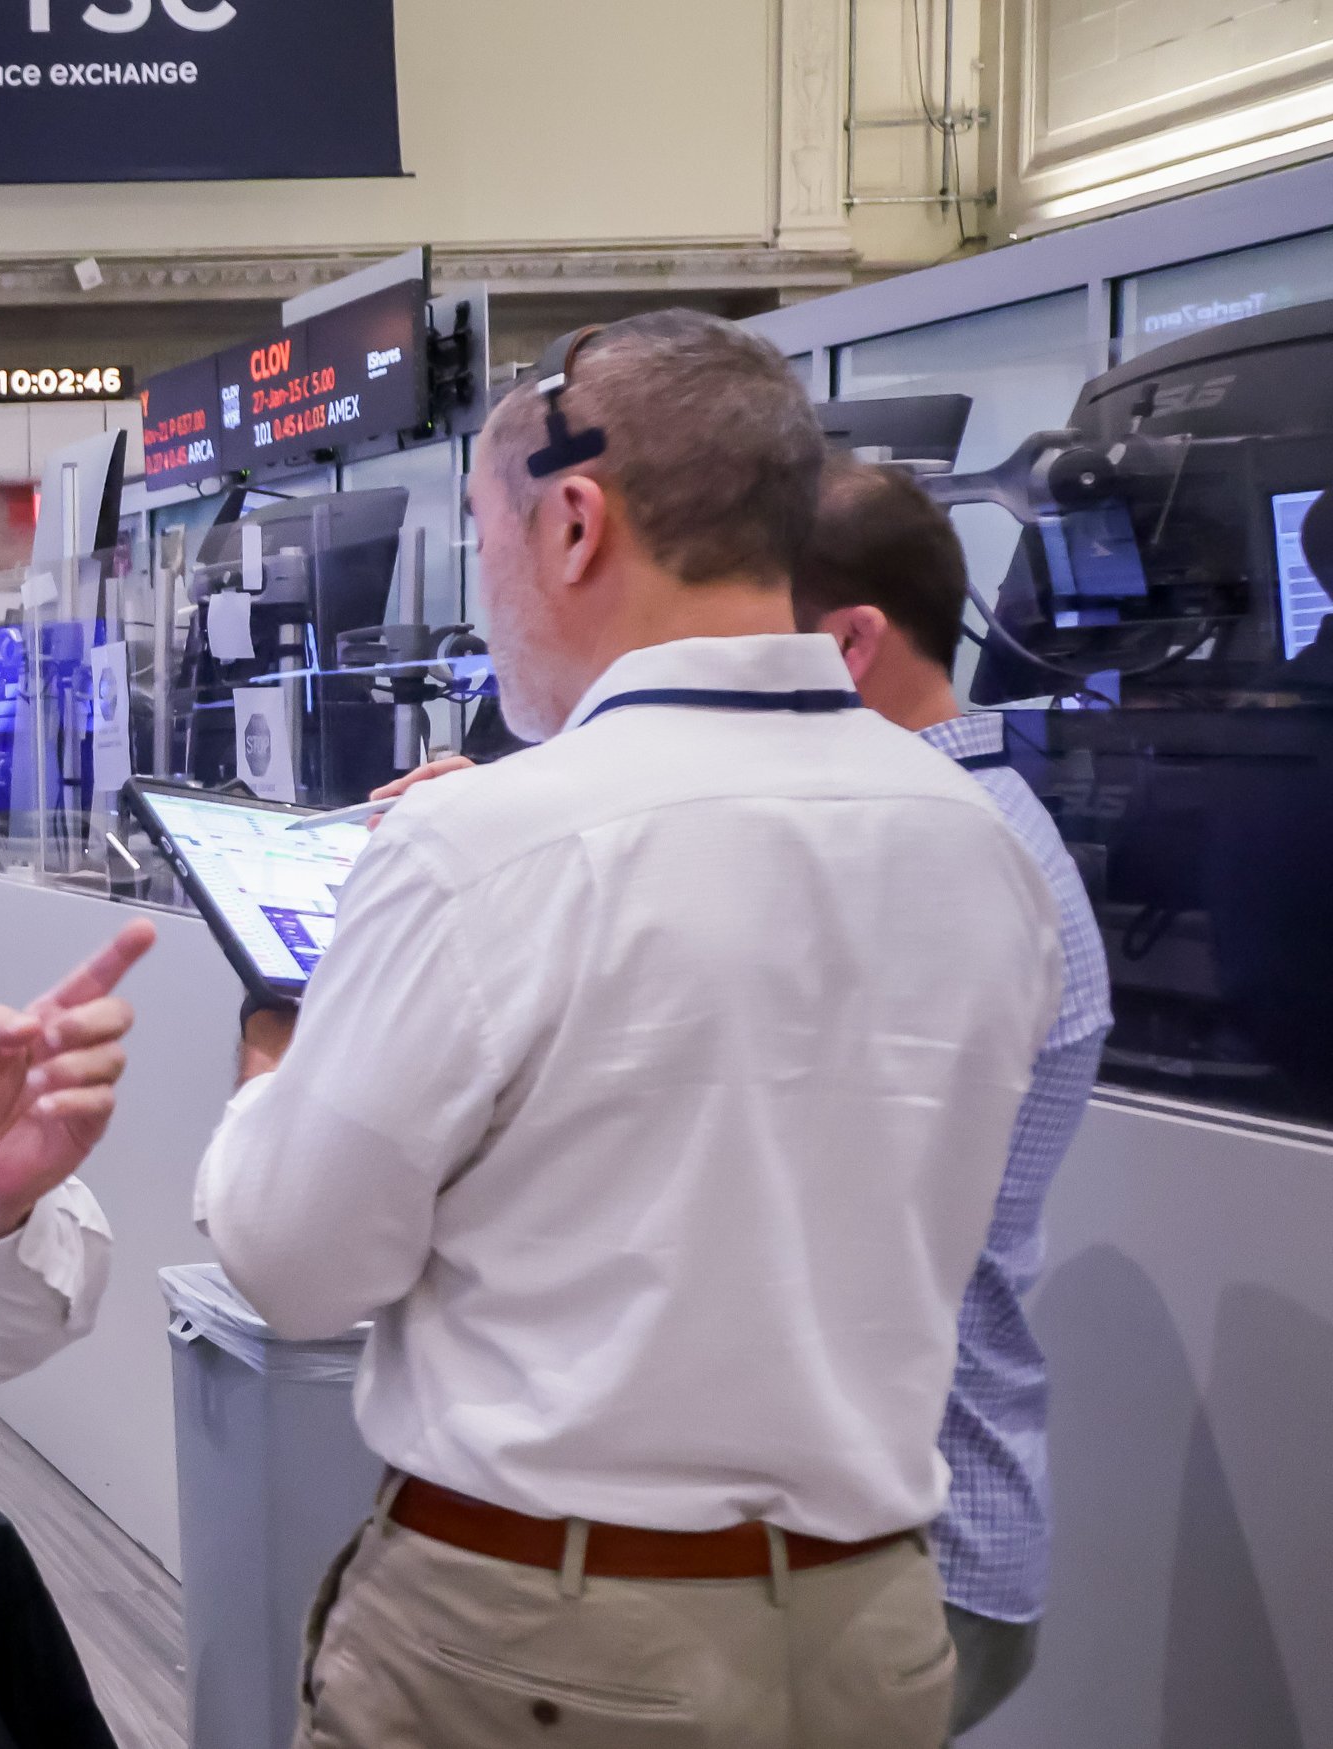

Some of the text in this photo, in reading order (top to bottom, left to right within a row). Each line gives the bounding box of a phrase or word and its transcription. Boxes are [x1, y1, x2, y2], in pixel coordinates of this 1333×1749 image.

[250, 339, 292, 383] CLOV
[254, 423, 274, 448] 101
[327, 394, 361, 427] AMEX
[188, 438, 215, 464] ARCA
[245, 734, 271, 755] STOP
